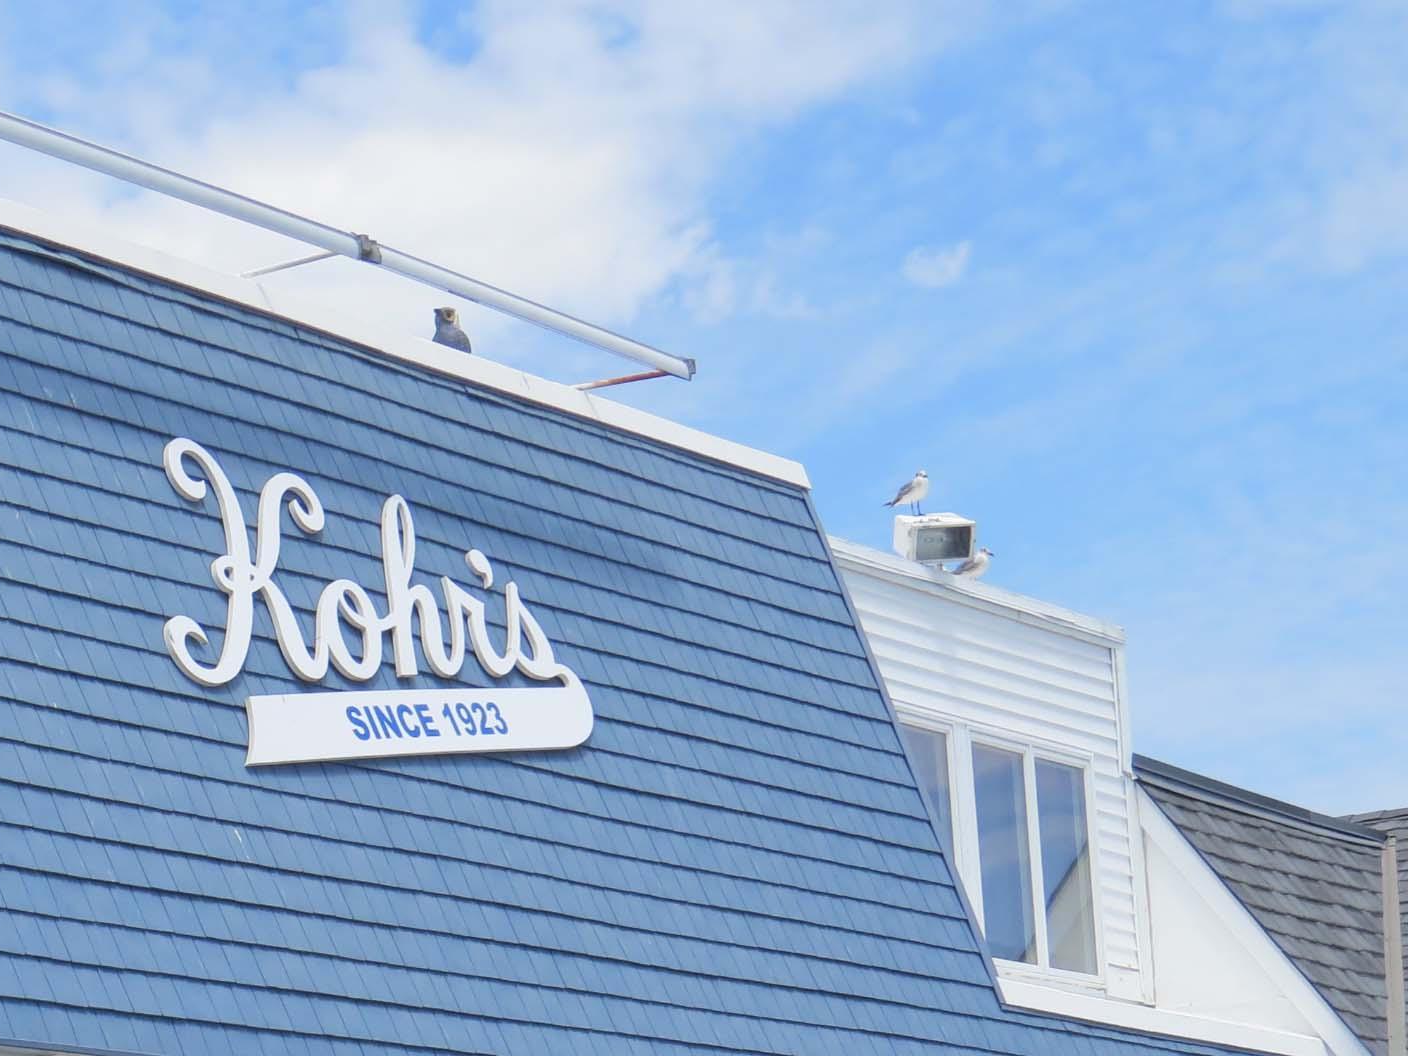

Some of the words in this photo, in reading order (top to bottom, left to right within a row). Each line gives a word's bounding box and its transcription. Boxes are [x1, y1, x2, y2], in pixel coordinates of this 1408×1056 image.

[163, 437, 567, 687] Kohr's
[346, 704, 440, 741] SINCE
[443, 702, 508, 736] 1923
